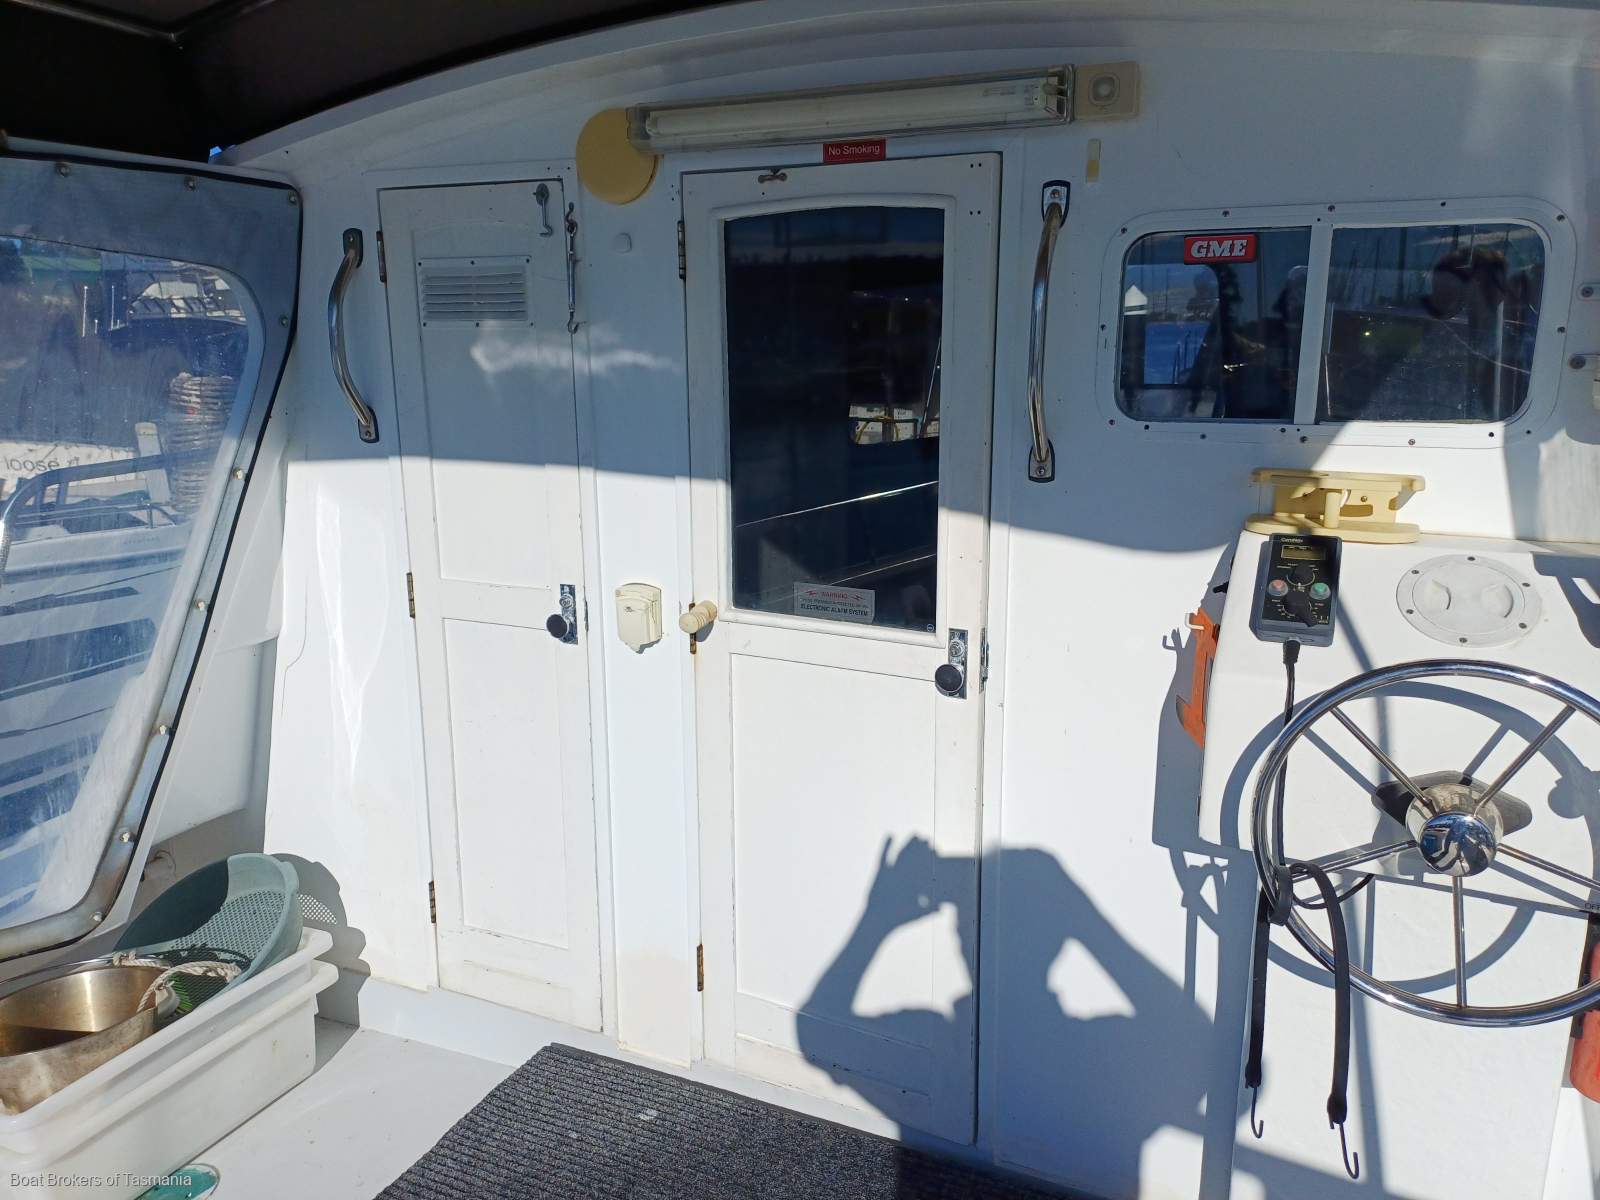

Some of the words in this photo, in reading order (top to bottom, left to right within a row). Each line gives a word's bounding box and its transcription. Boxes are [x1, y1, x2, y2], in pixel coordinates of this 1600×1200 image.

[828, 145, 841, 156] No
[843, 144, 880, 155] Smoking
[1190, 239, 1248, 258] GME
[800, 603, 830, 612] ELECTRONIC
